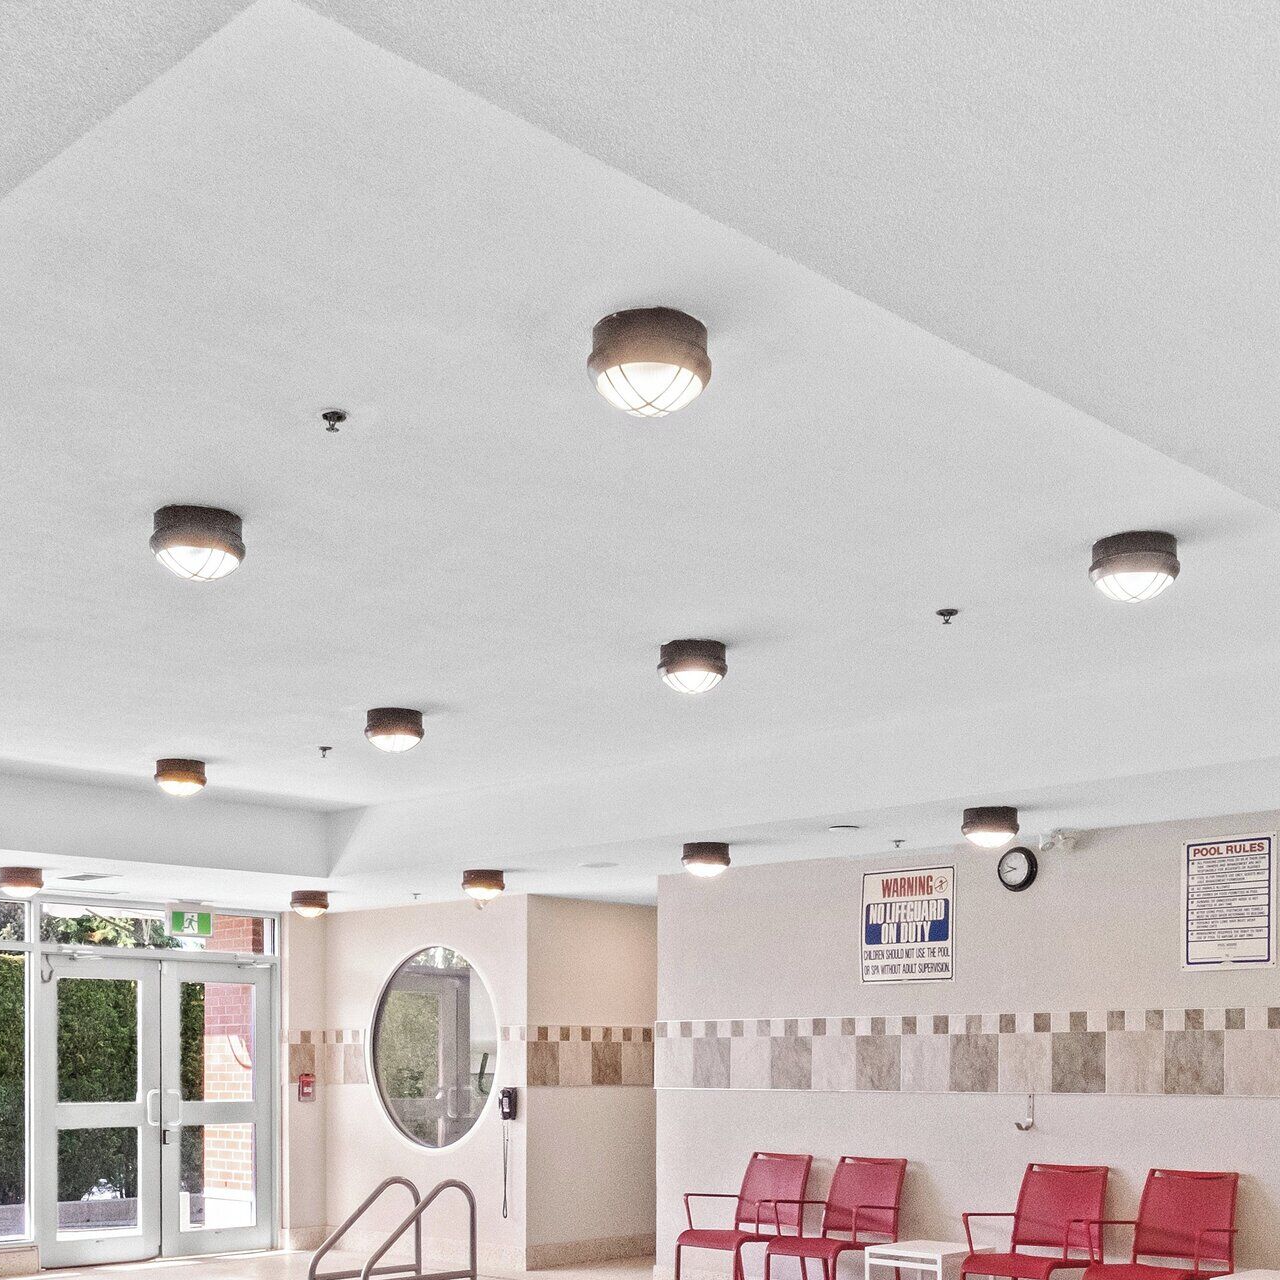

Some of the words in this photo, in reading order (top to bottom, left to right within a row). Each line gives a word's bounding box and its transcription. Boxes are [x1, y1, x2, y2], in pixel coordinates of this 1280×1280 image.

[1193, 847, 1223, 857] POOL
[1226, 842, 1265, 854] RULES
[881, 875, 933, 898] WARNING
[869, 903, 885, 924] NO
[885, 899, 945, 922] LIFEGUARD
[881, 922, 897, 944] ON
[900, 920, 931, 943] DUTY
[864, 949, 884, 960] CHILDREN
[886, 948, 904, 960] SHOULD
[905, 948, 915, 959] NOT
[916, 947, 925, 958] USE
[927, 946, 936, 958] THE
[937, 946, 950, 957] POOL
[864, 965, 870, 975] OR
[871, 964, 880, 975] SPA
[881, 963, 901, 975] WITHOUT
[902, 963, 917, 974] ADULT
